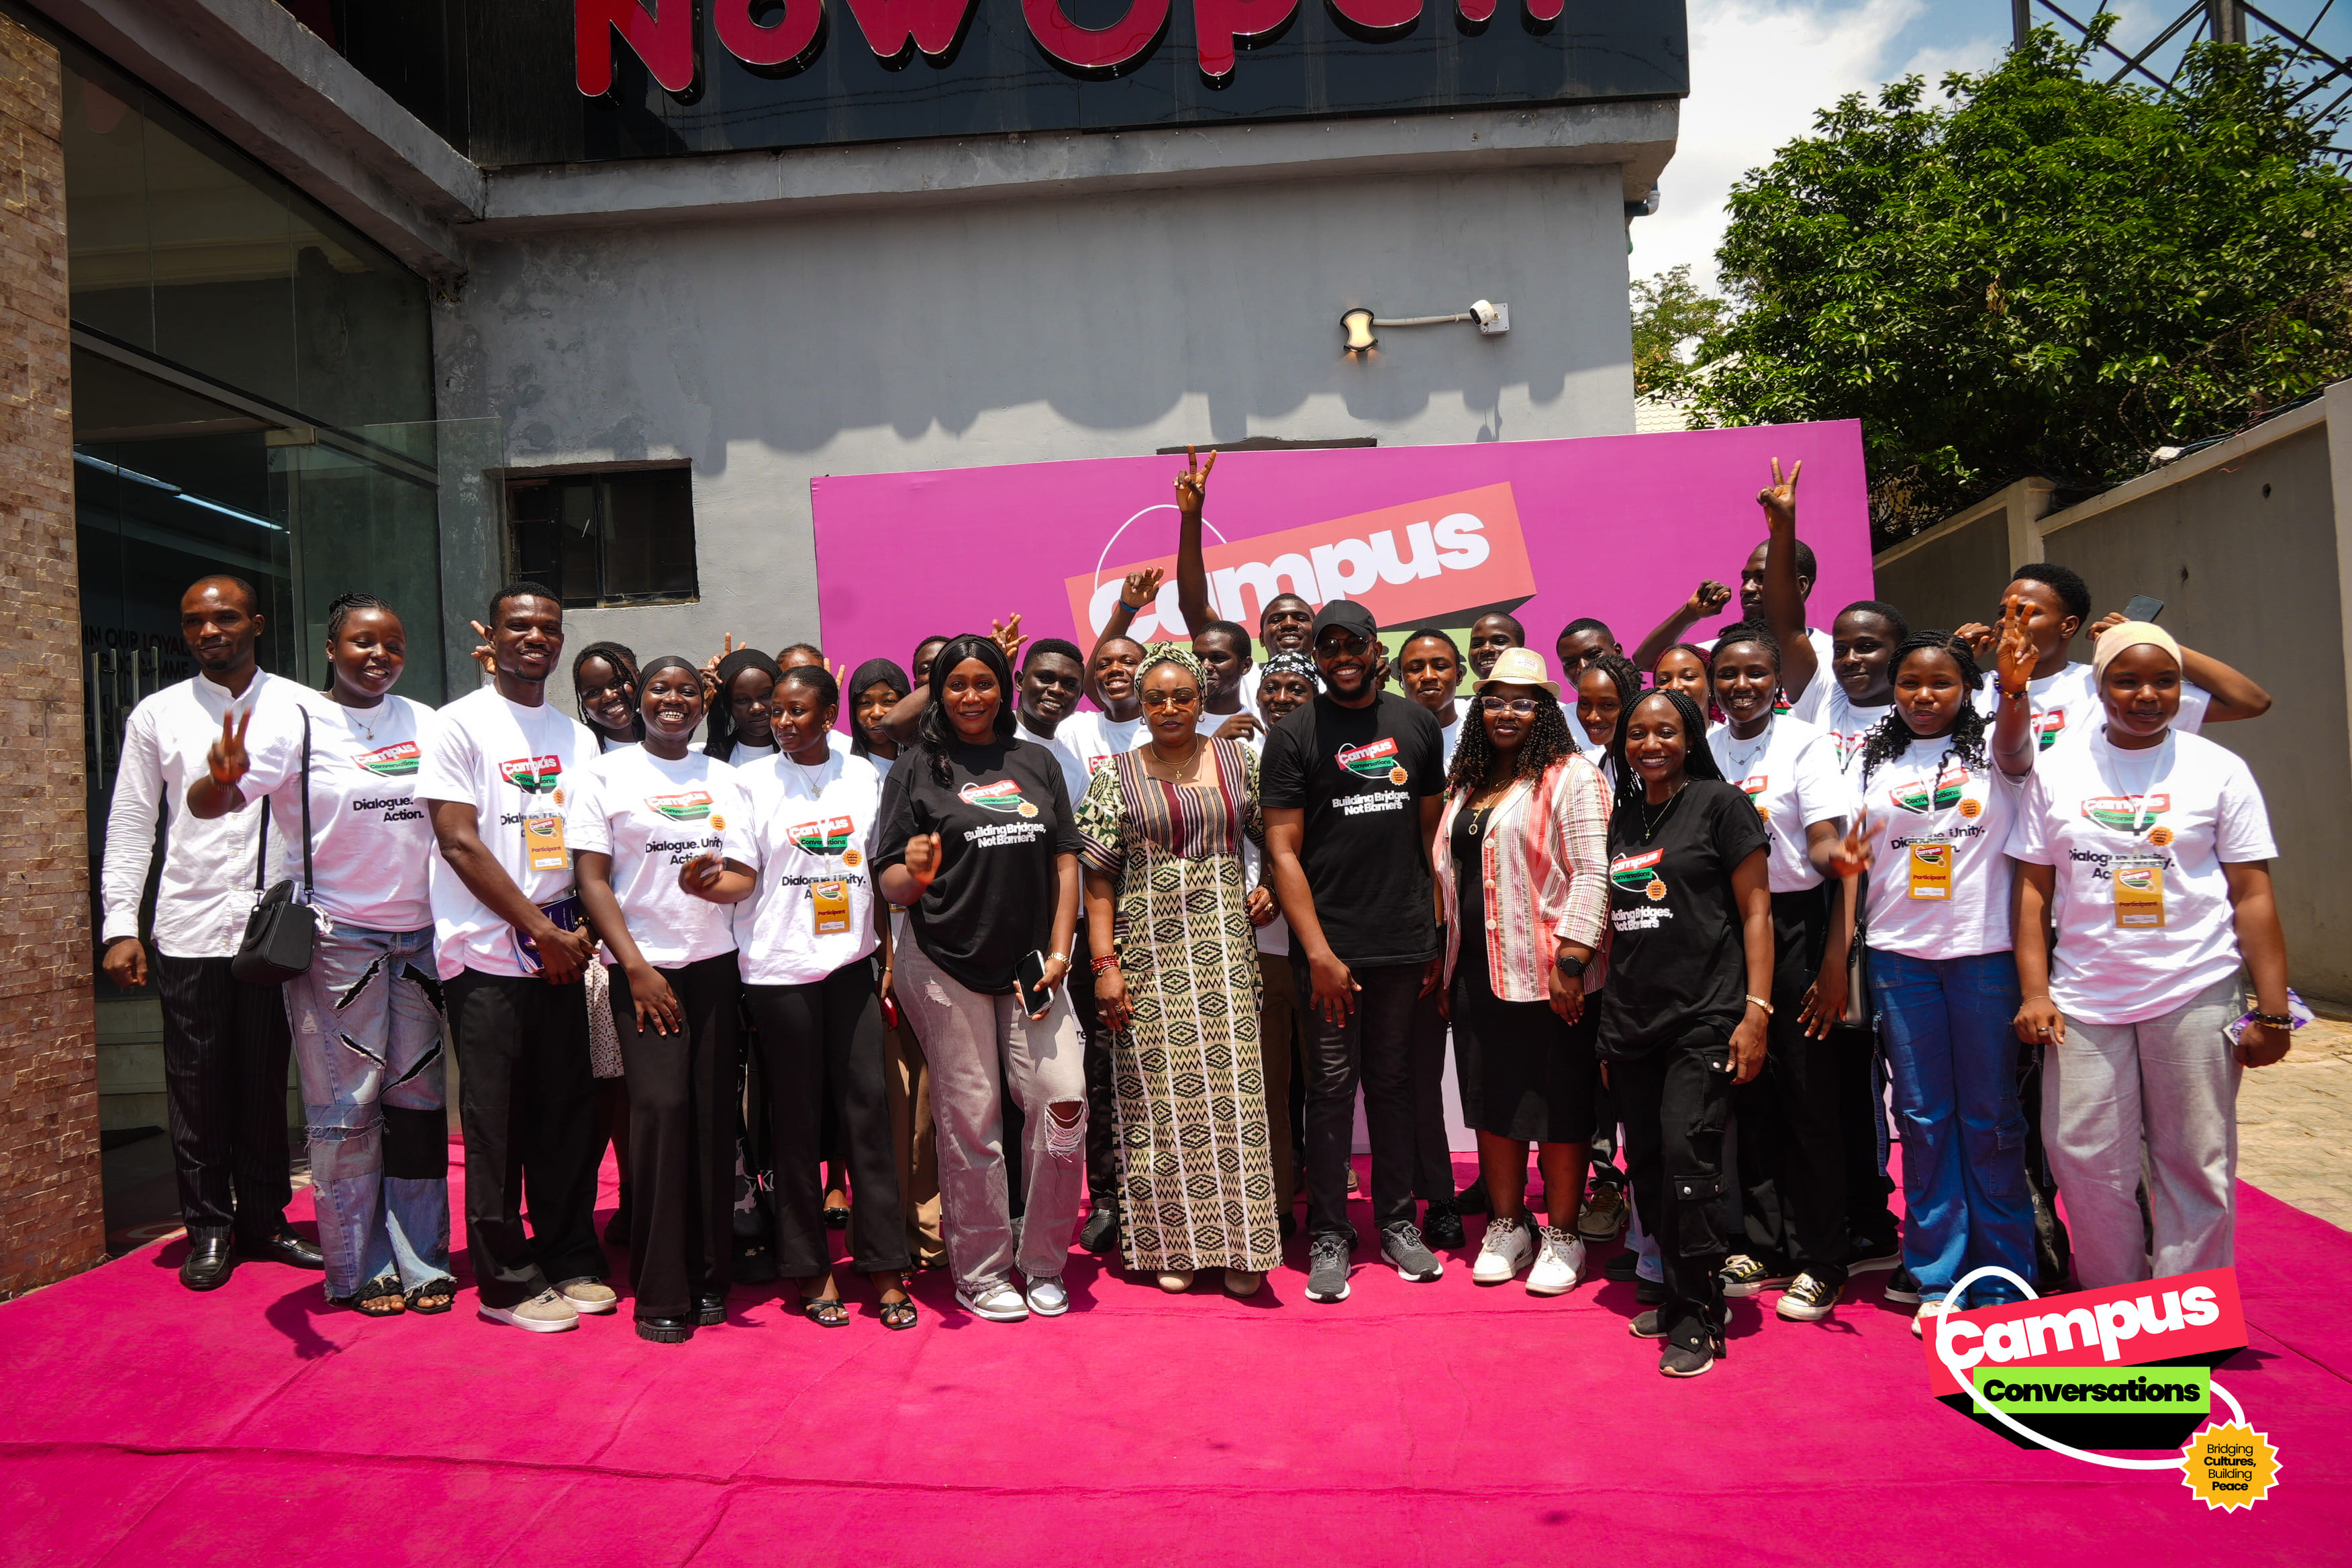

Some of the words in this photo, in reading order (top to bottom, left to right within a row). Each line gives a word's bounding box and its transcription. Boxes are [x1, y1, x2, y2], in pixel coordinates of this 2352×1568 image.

[355, 744, 415, 763] Campus
[1339, 741, 1392, 763] Campus
[1350, 759, 1391, 769] Conversations
[964, 782, 1015, 798] Campus
[353, 797, 413, 811] Dialogue.
[648, 792, 707, 807] Campus
[1332, 794, 1374, 807] Building
[1374, 790, 1410, 803] Bridges,
[383, 810, 424, 822] Action.
[1344, 806, 1364, 816] Not
[1364, 801, 1403, 813] Barriers
[963, 824, 1006, 841] Building
[1006, 822, 1046, 834] Bridges,
[646, 840, 699, 853] Dialogue.
[978, 836, 997, 848] Not
[997, 833, 1036, 845] Barriers
[1610, 852, 1658, 873] Campus
[1612, 871, 1651, 881] Conversations
[1635, 905, 1674, 920] Bridges,
